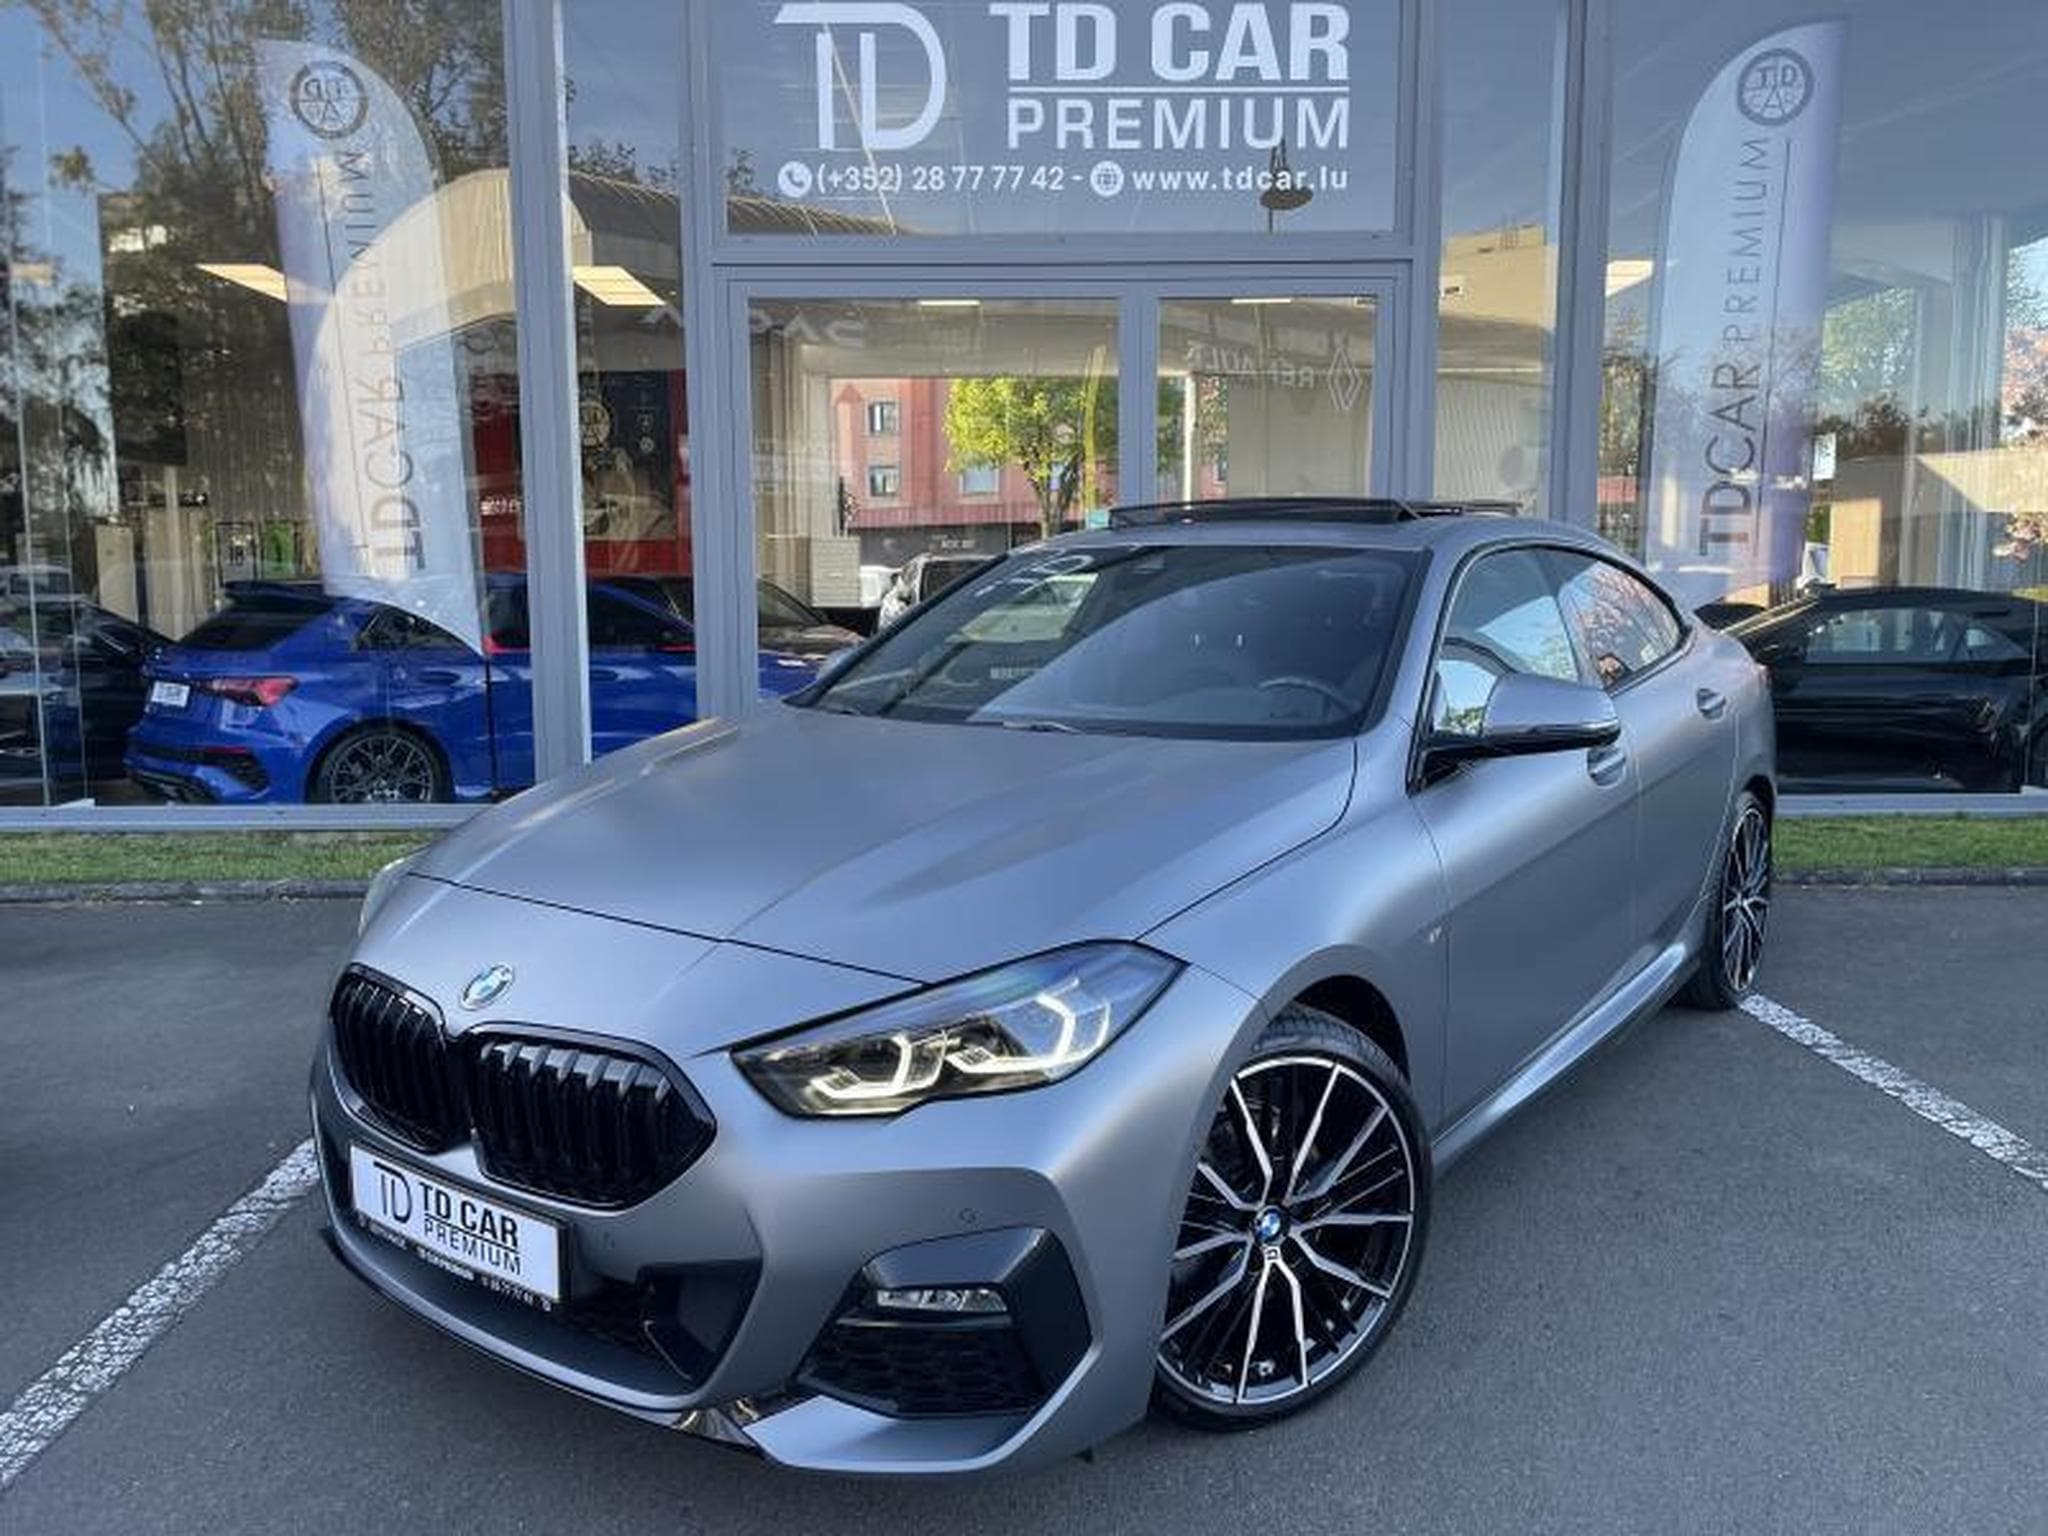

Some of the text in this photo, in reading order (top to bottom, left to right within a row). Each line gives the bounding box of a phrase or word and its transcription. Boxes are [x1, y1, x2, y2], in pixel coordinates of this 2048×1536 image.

[989, 1, 1350, 81] TD CAR
[1007, 99, 1350, 150] PREMIUM
[817, 162, 903, 194] (+352)
[912, 165, 946, 192] 28
[951, 165, 985, 192] 77
[991, 165, 1025, 192] 77
[1030, 165, 1066, 192] 42
[1132, 165, 1348, 191] www.tdcar.lu
[1722, 137, 1771, 343] PREMIUM
[419, 1182, 520, 1248] TD CAR
[424, 1218, 521, 1276] PREMIUM
